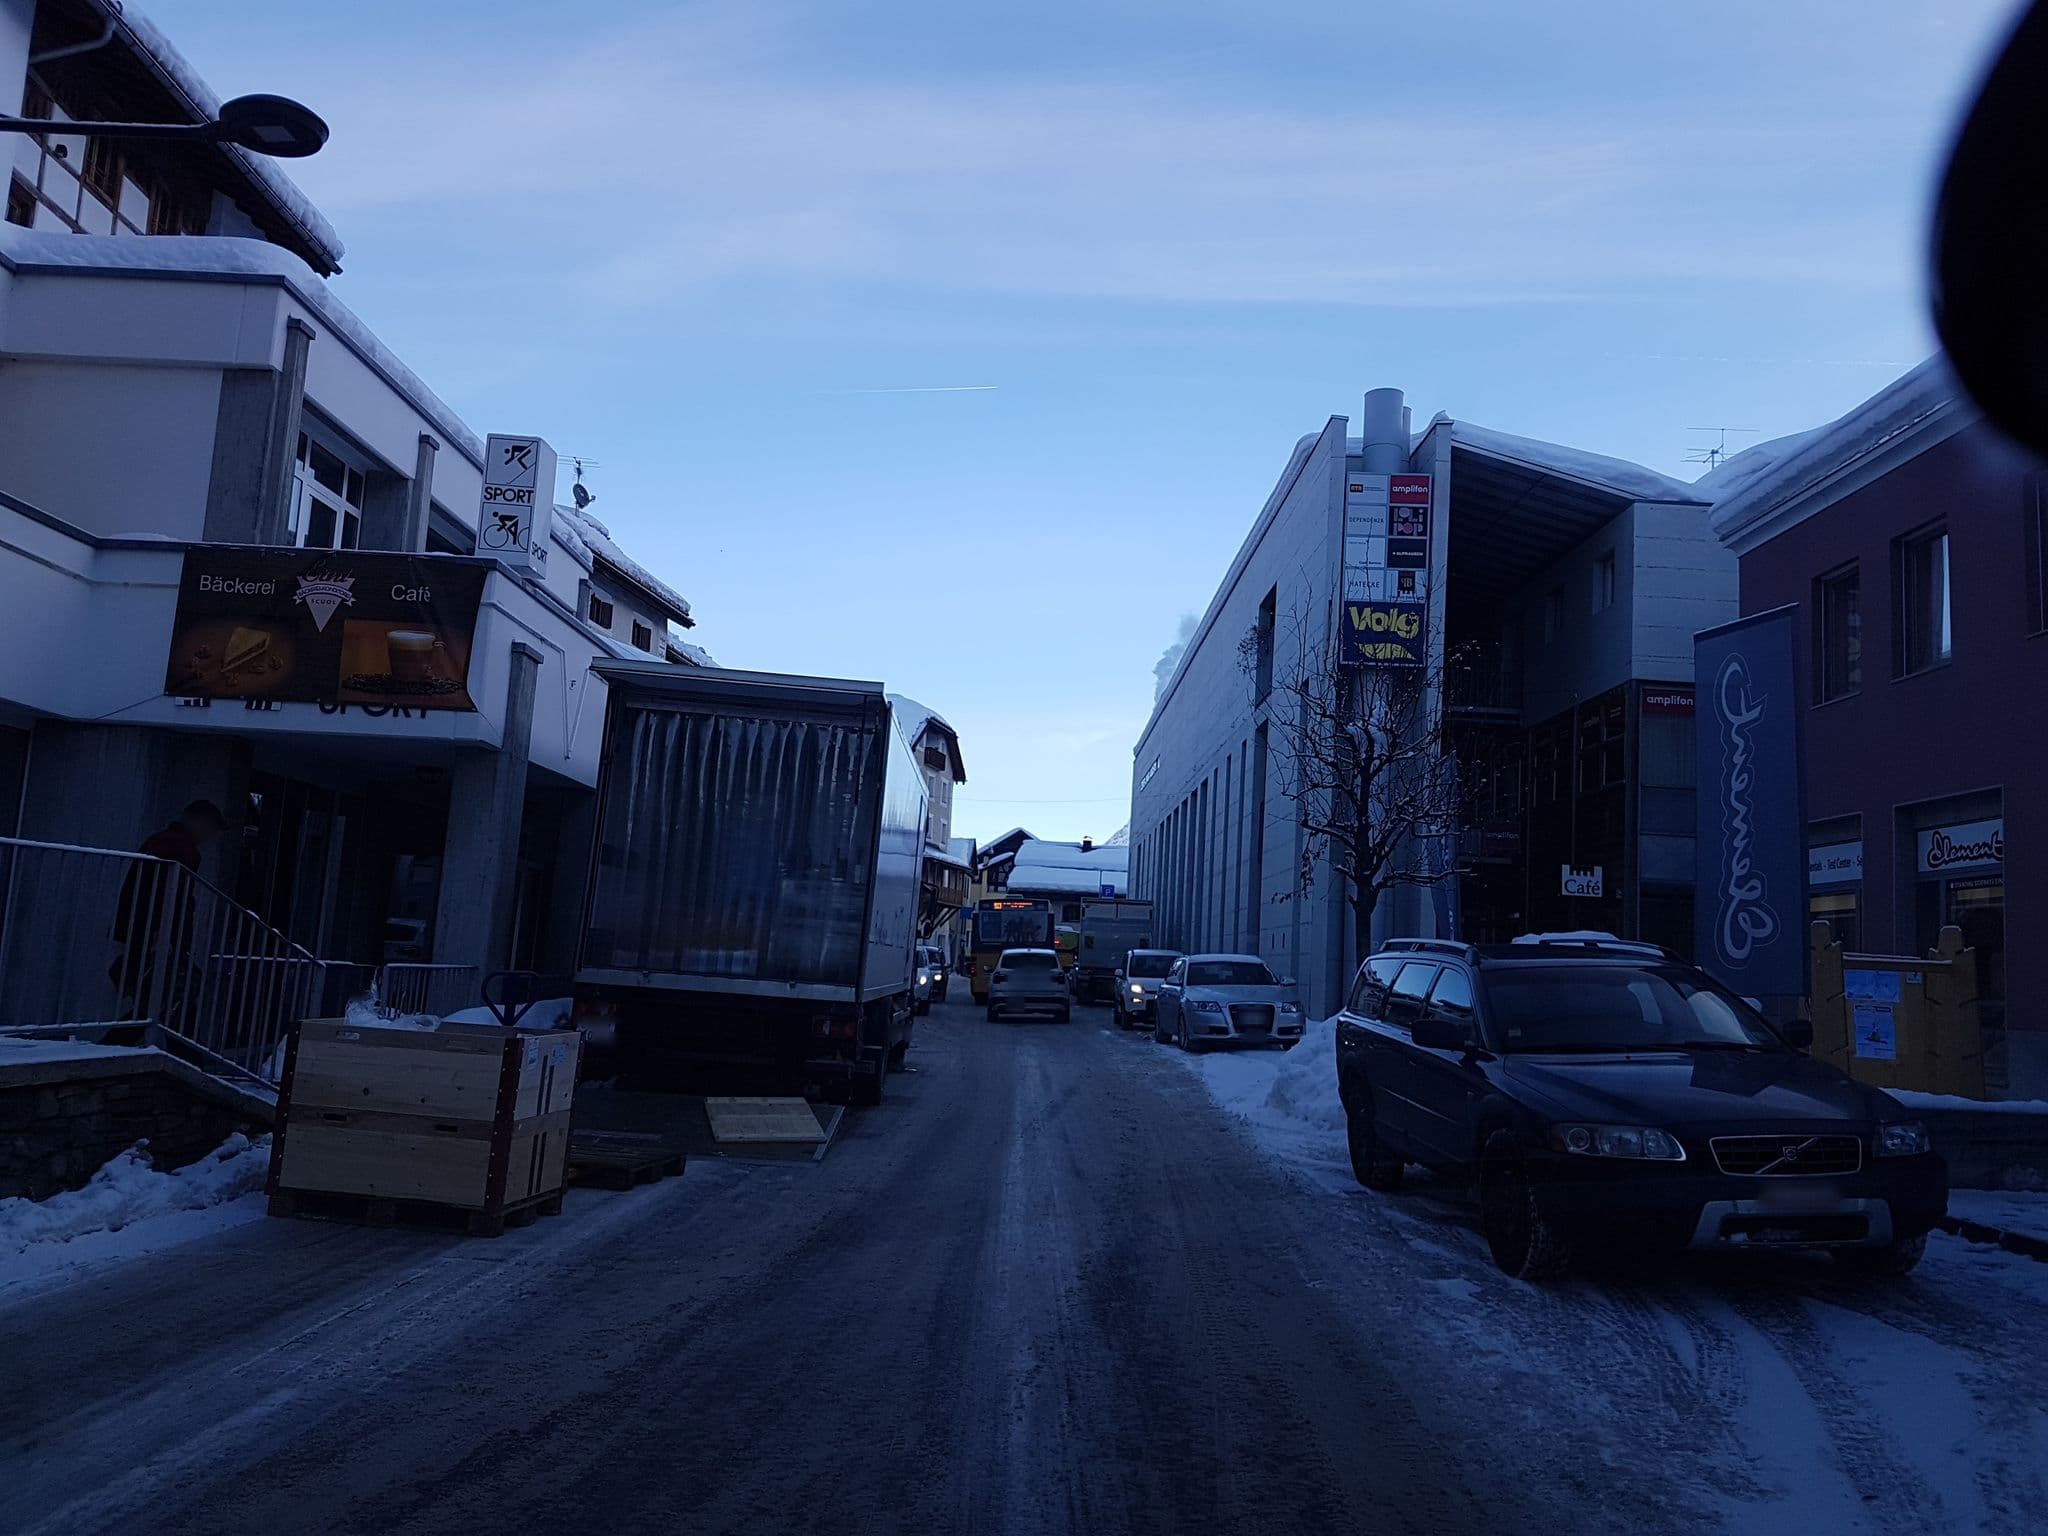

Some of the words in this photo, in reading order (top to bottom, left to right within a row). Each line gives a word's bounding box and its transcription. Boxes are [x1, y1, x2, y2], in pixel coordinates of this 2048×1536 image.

[483, 486, 534, 503] SPORT
[1392, 485, 1428, 494] amplifon
[199, 574, 276, 595] Bäckerei
[391, 584, 432, 602] Café
[1348, 606, 1420, 640] Volg
[1646, 695, 1694, 707] amplifon
[1563, 879, 1601, 896] Café
